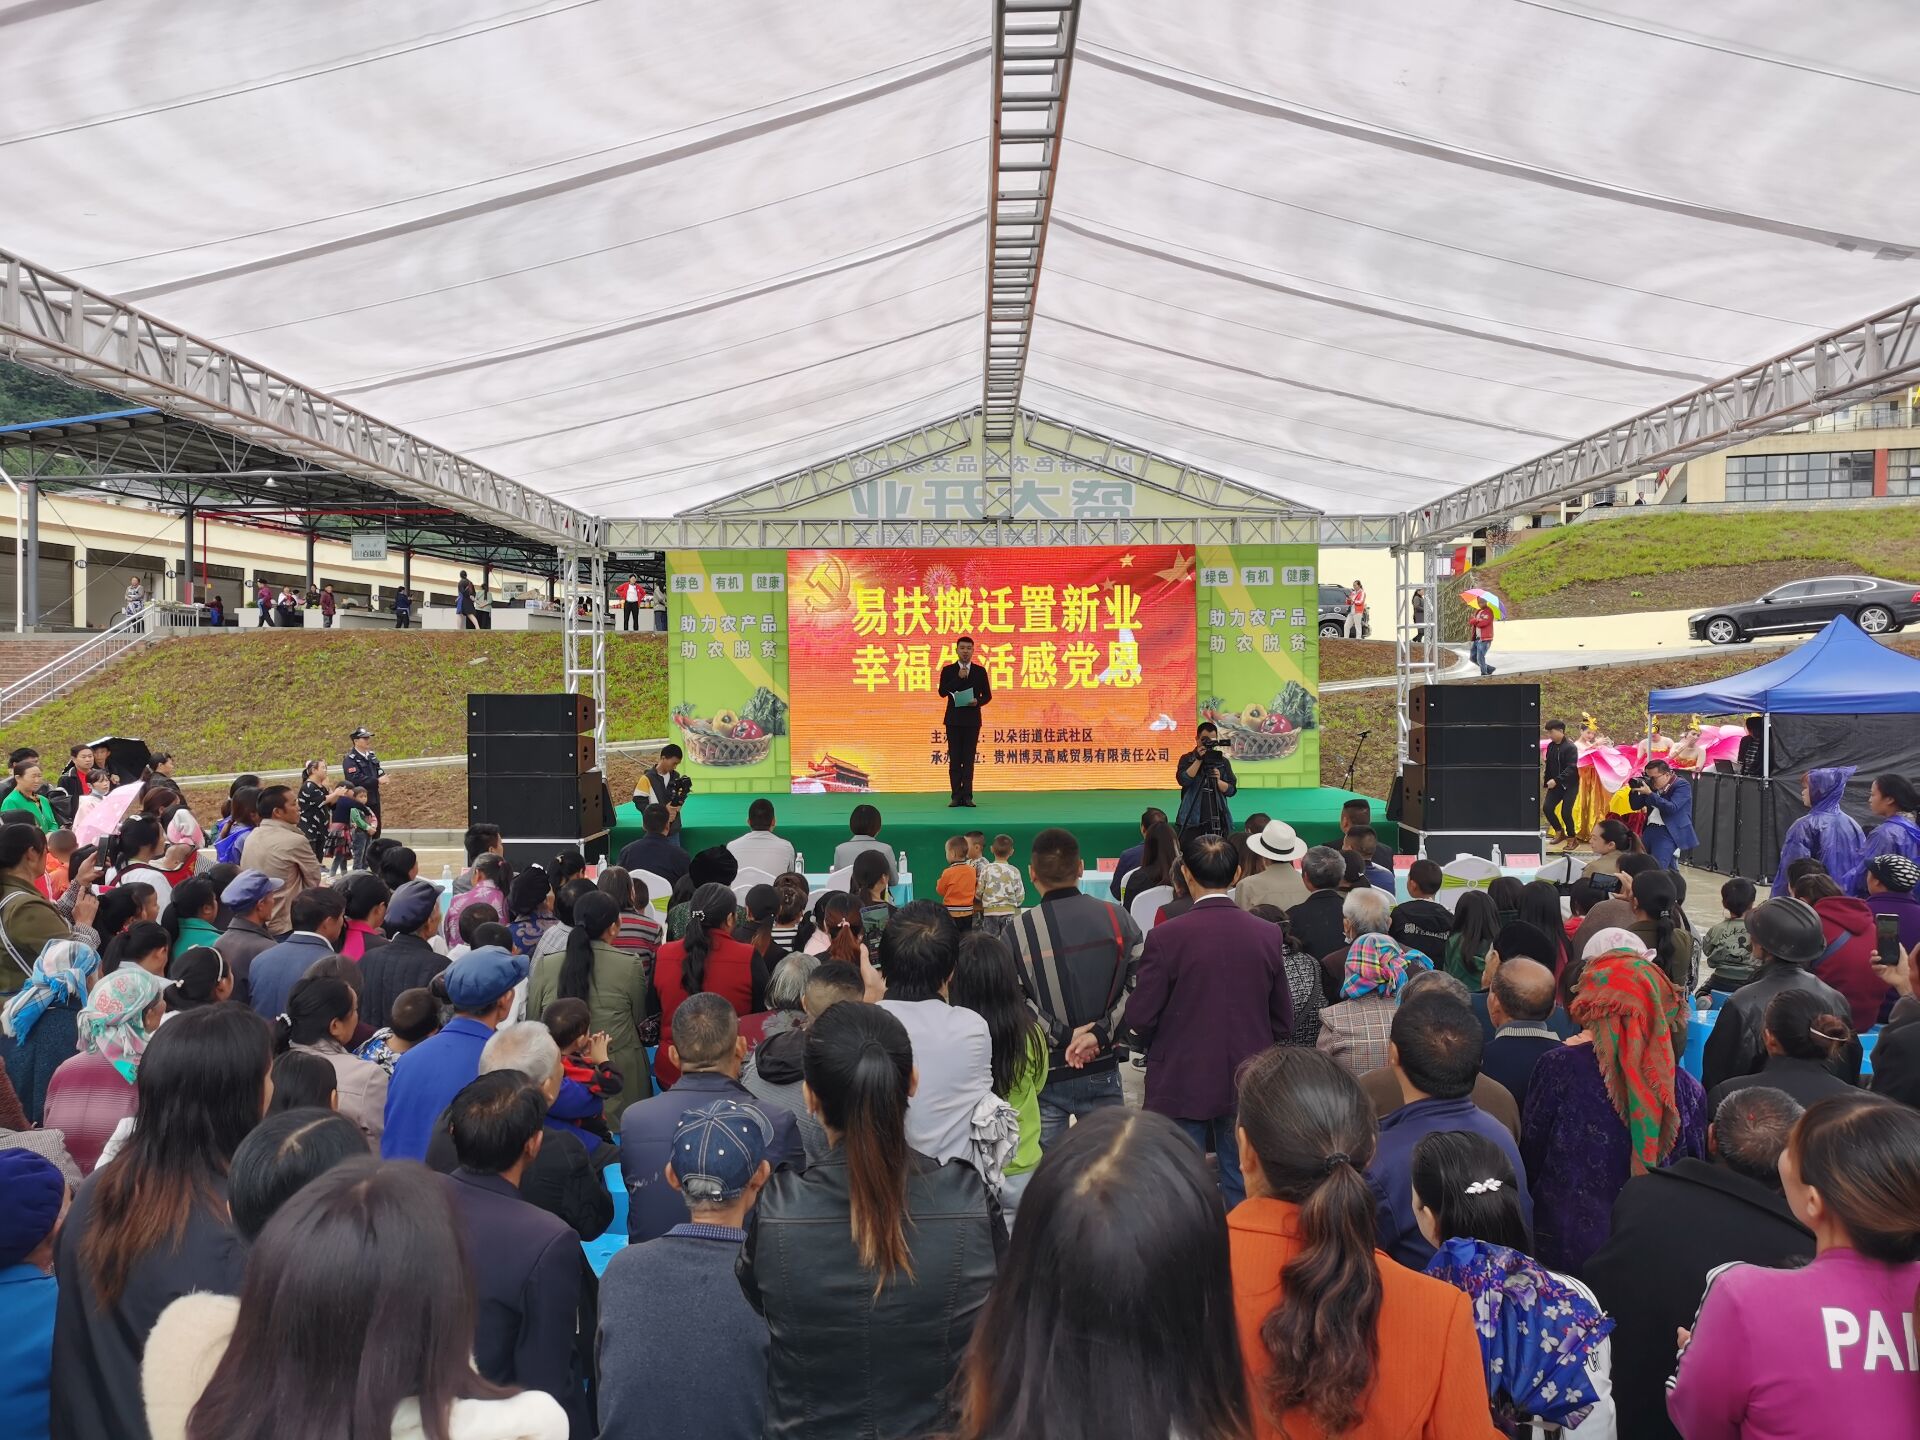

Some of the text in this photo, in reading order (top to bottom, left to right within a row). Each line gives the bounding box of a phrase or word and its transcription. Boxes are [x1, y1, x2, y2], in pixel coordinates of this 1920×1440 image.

[676, 576, 779, 590] 绿色 有机 健康
[1205, 569, 1310, 583] 绿色 有机 健康
[852, 584, 1142, 636] 易扶搬迁置新业
[1209, 608, 1306, 627] 助力农产品
[681, 615, 777, 633] 助力农产品
[681, 641, 776, 658] 助农脱贫
[1209, 634, 1306, 653] 助农脱贫
